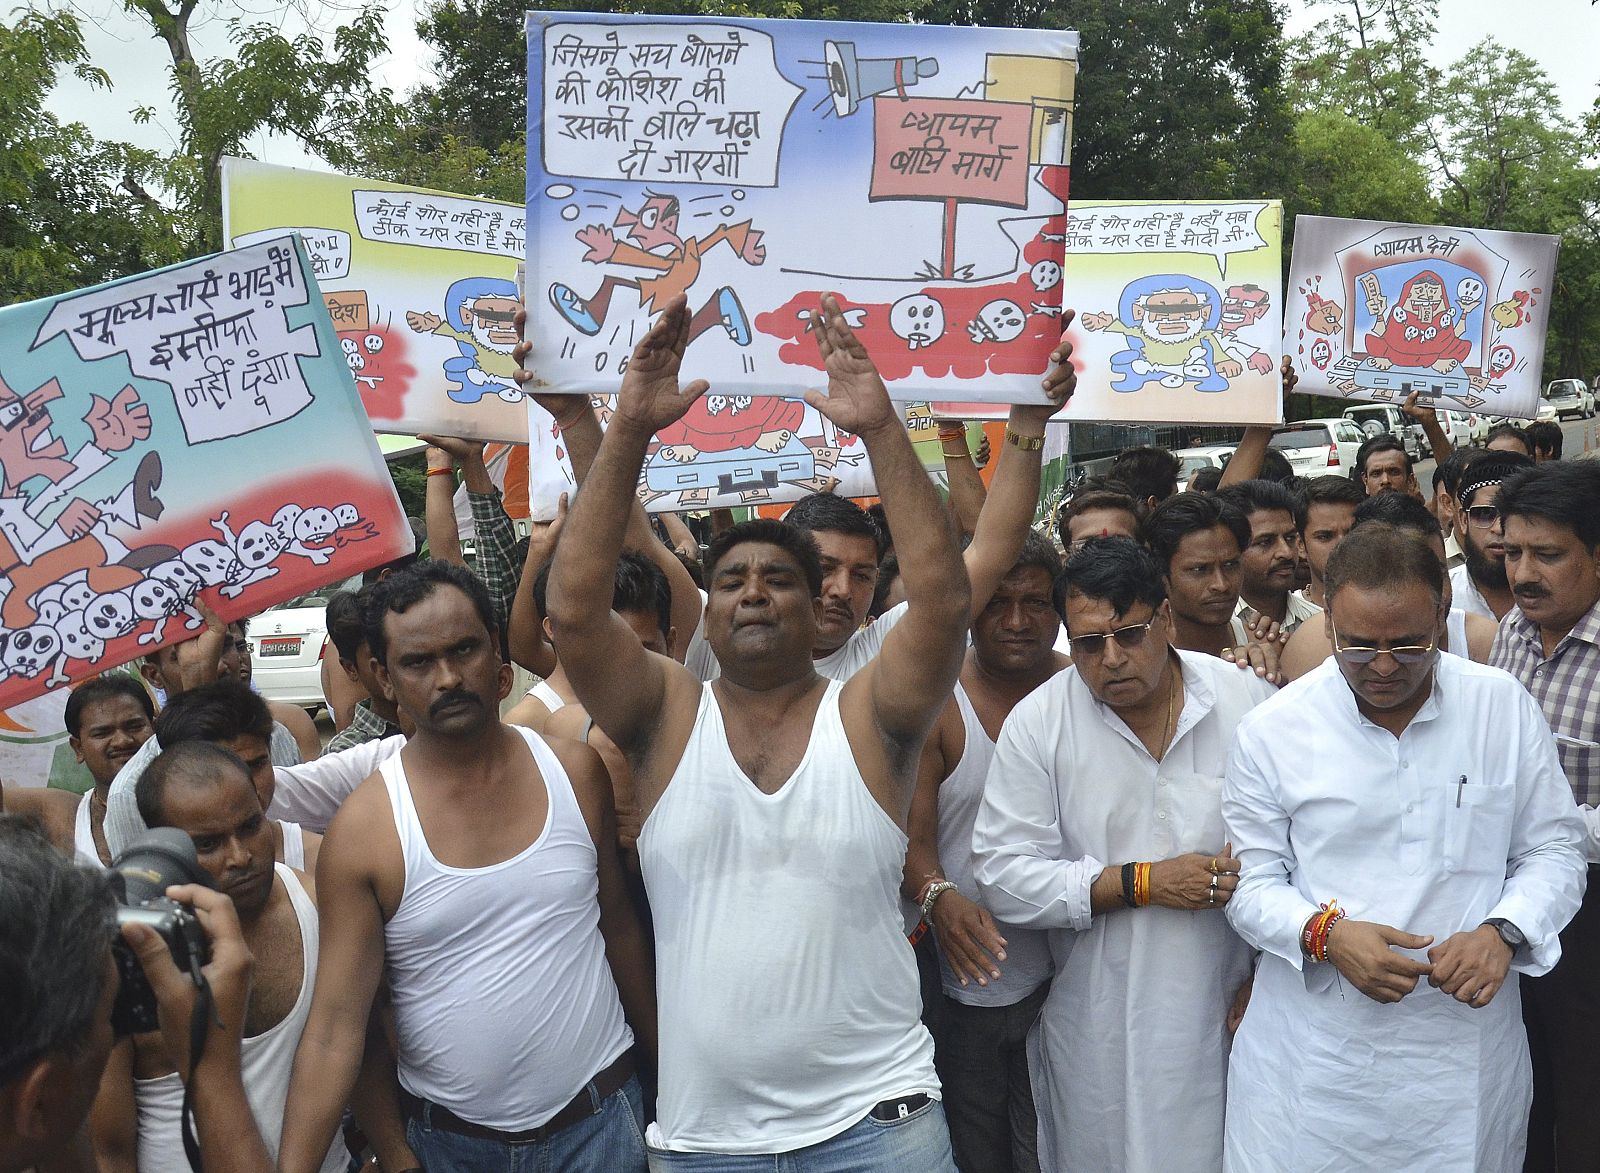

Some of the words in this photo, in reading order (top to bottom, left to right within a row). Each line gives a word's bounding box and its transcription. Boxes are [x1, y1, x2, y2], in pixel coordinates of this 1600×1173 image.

[552, 31, 627, 68] जिसने
[629, 44, 677, 69] सच
[681, 32, 749, 68] बोलने
[556, 71, 591, 105] की
[597, 67, 682, 104] कोशिश
[693, 68, 725, 104] की
[558, 106, 633, 142] उसकी
[901, 112, 1001, 144] व्यापम
[618, 140, 656, 178] दी
[658, 142, 748, 180] जाएगी
[952, 145, 1019, 181] मार्ग
[367, 199, 411, 219] कोई
[415, 204, 448, 224] शोर
[451, 209, 490, 228] नहीं
[1101, 215, 1131, 231] शोर
[1133, 212, 1172, 230] नहीं
[1225, 211, 1252, 225] सब
[373, 218, 409, 237] ठीक
[416, 227, 449, 242] चल
[455, 231, 480, 246] रहा
[484, 230, 498, 250] है
[1099, 234, 1130, 247] चल
[1135, 234, 1160, 247] रहा
[1164, 230, 1176, 247] है
[1181, 228, 1219, 247] मोदी
[1374, 236, 1424, 257] व्यापम
[1427, 234, 1460, 257] देवी
[73, 294, 157, 345] मूल्य
[268, 246, 294, 288] में
[150, 309, 258, 370] इस्तीफा
[185, 355, 235, 410] नहीं
